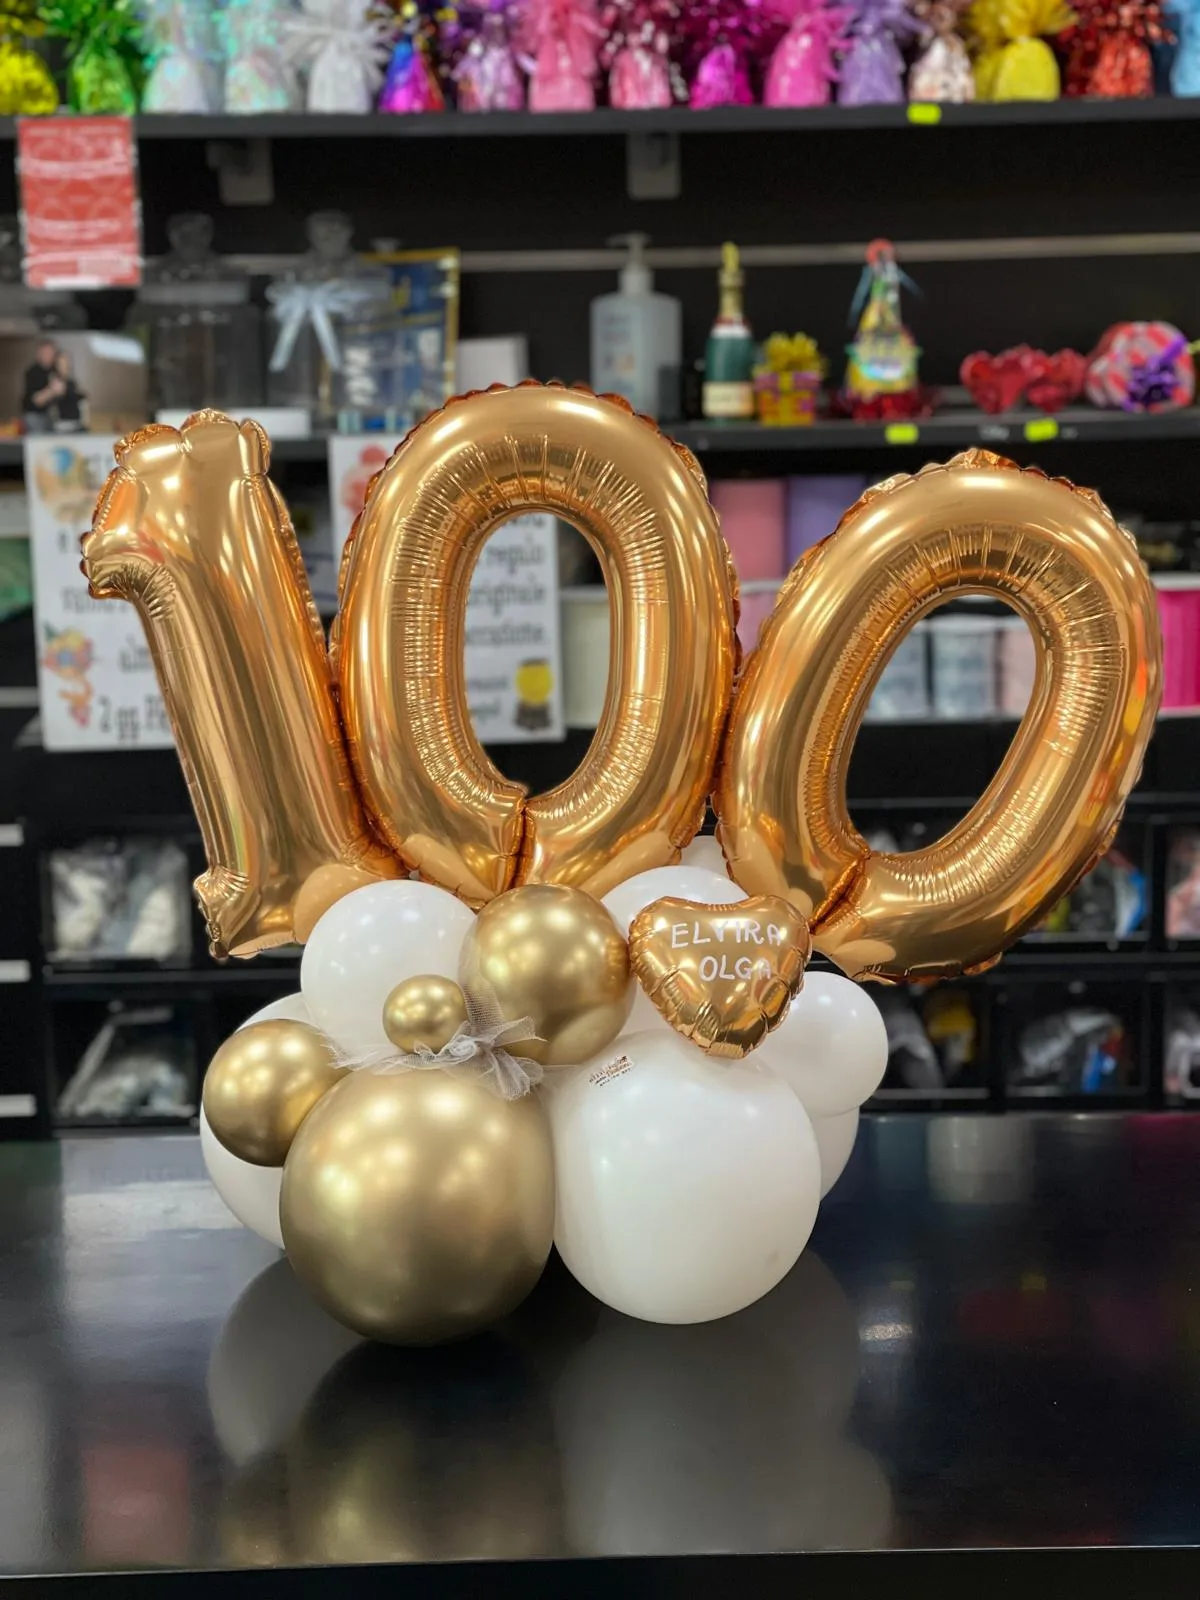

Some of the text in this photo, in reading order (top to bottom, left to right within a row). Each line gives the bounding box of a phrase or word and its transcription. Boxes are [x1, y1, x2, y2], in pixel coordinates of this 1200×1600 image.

[80, 380, 1164, 984] 100
[671, 919, 782, 949] ELVIRA
[699, 954, 772, 982] OLGA
